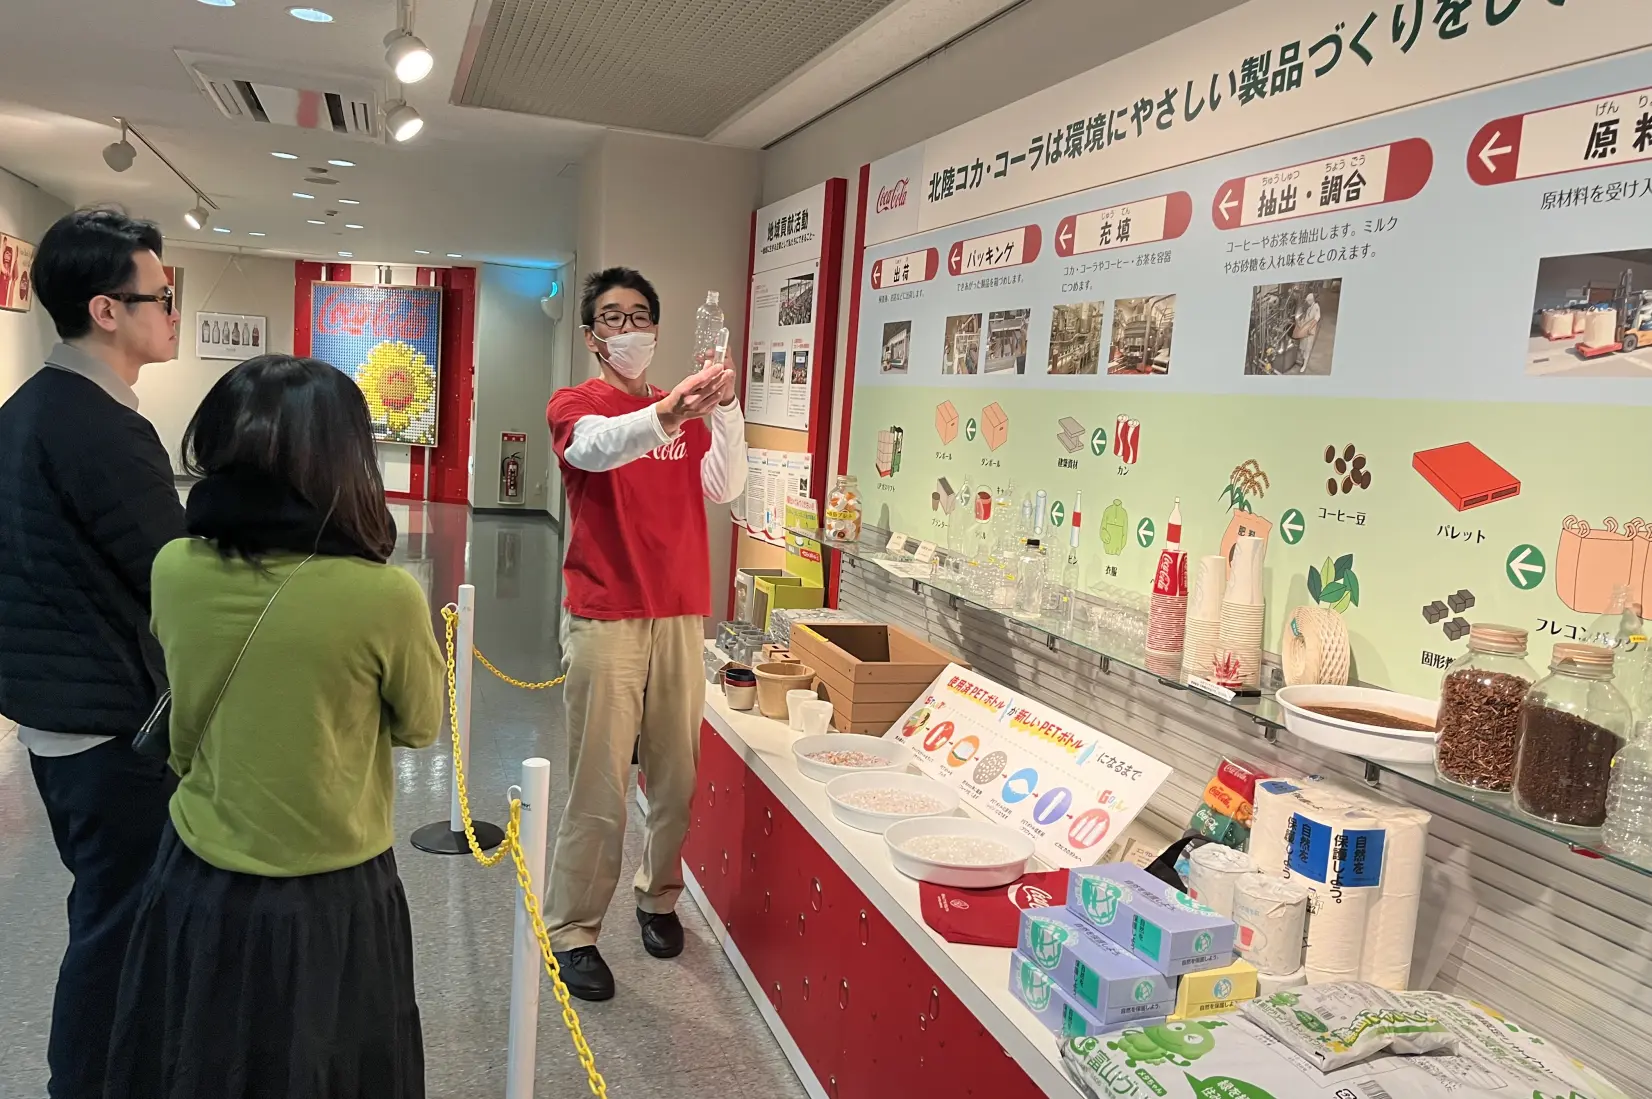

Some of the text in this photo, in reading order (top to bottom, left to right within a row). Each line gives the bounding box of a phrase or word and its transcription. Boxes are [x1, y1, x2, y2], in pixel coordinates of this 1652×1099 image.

[1596, 95, 1652, 116] げん り
[1257, 169, 1367, 218] 抽出・調合
[1099, 217, 1132, 246] 充填
[966, 241, 1015, 268] パッキング
[893, 264, 910, 283] 出荷
[1117, 466, 1129, 476] カン
[1318, 507, 1366, 526] コーヒー豆
[1436, 524, 1486, 544] パレット
[1353, 836, 1367, 874] 自然を
